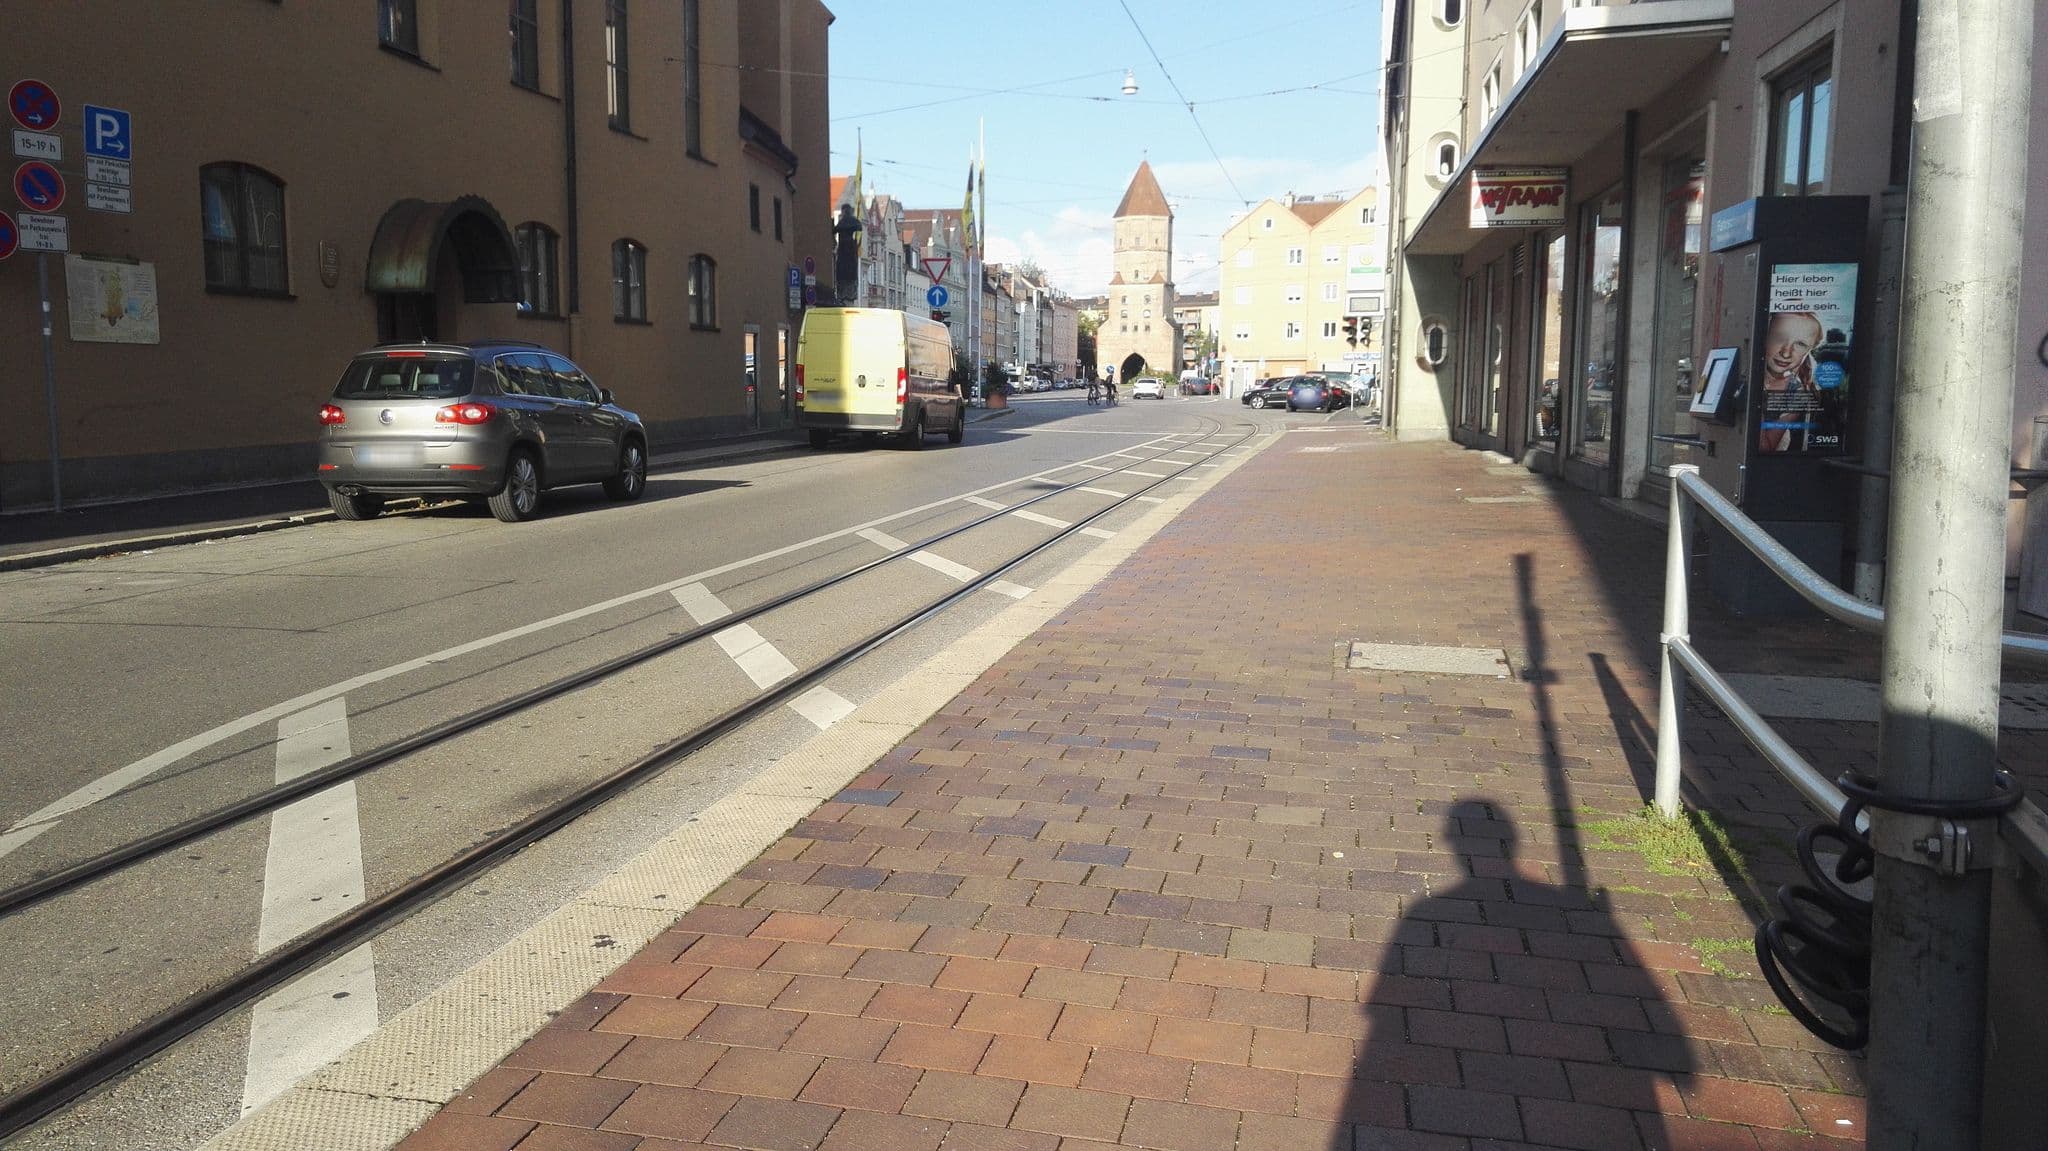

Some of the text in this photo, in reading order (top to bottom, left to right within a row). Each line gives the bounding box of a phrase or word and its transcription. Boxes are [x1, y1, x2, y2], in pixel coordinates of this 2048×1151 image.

[96, 113, 120, 149] P
[49, 142, 56, 152] h
[792, 270, 798, 285] P
[1776, 275, 1834, 283] Hier leben
[1775, 288, 1803, 297] heißt
[1774, 303, 1810, 311] Kunde
[1816, 435, 1839, 443] swa
